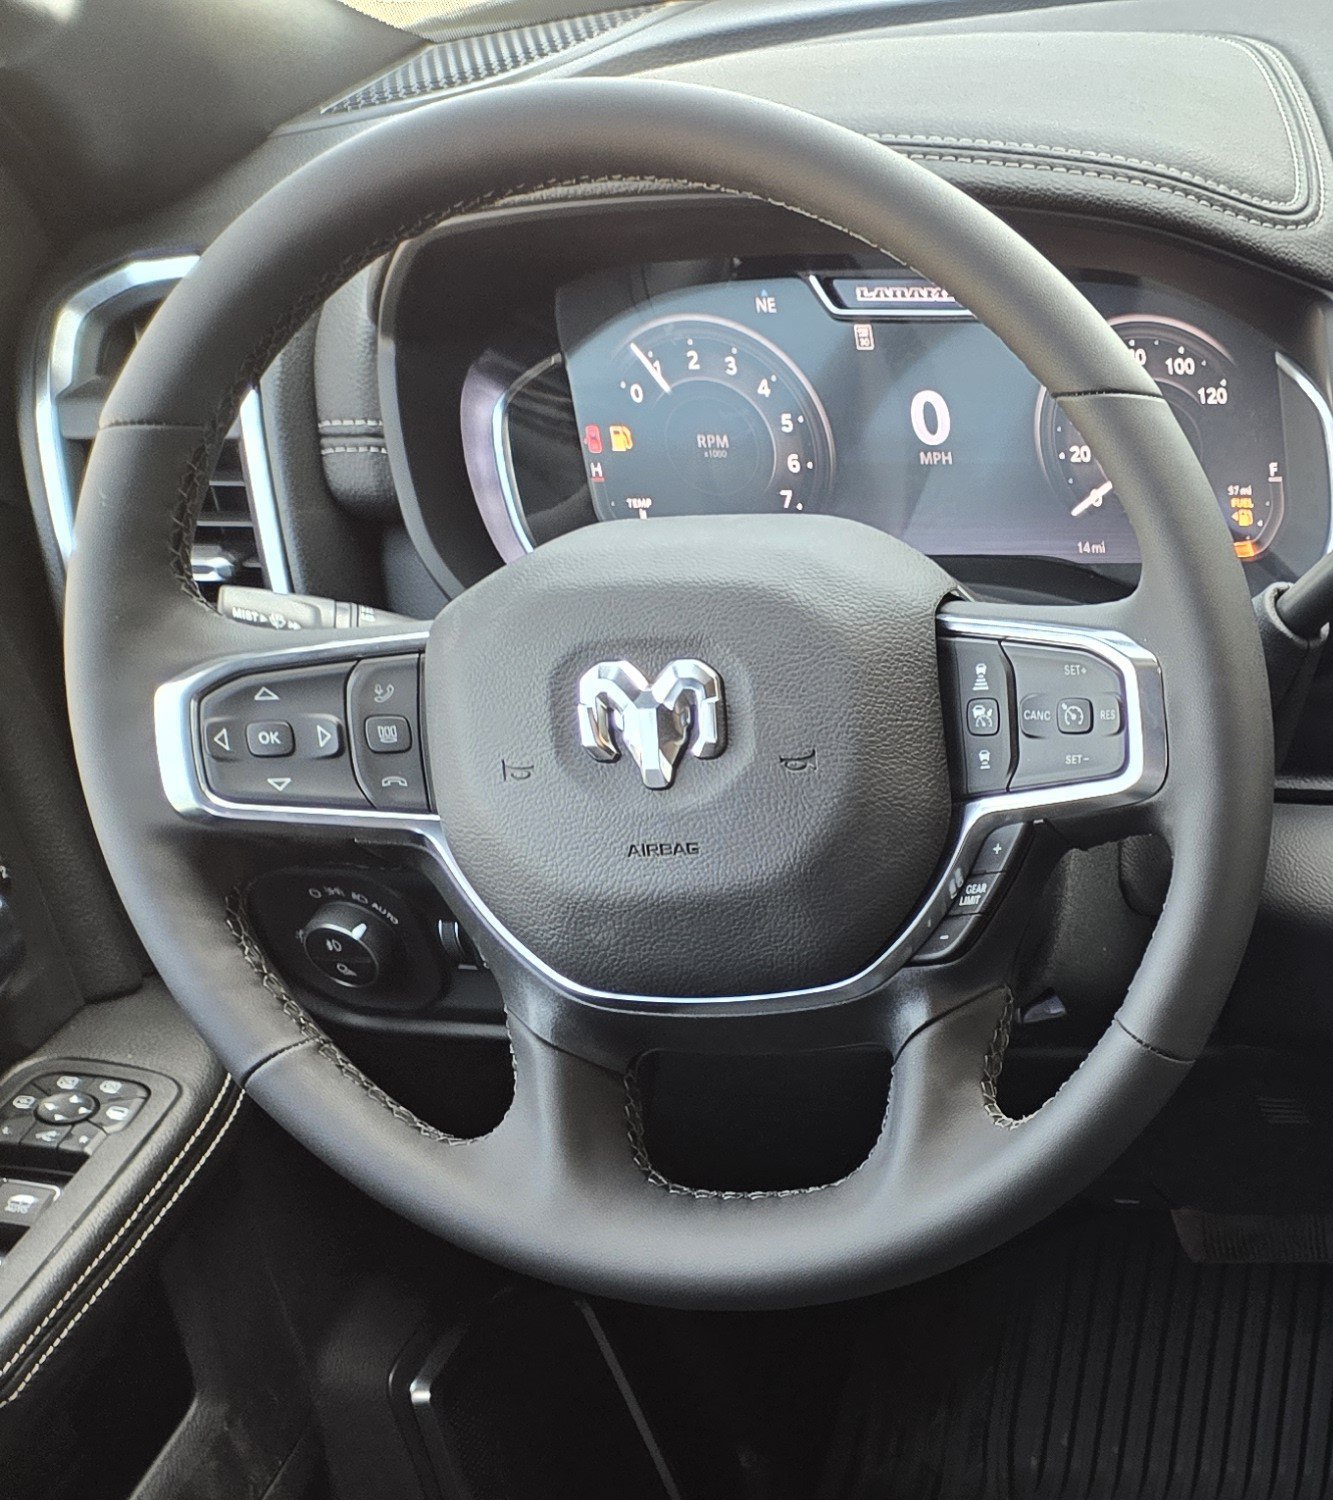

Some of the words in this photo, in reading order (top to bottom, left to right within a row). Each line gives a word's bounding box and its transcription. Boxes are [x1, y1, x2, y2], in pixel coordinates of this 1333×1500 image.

[755, 297, 777, 313] NE
[686, 350, 700, 370] 2
[725, 357, 738, 376] 3
[1165, 357, 1195, 376] 100
[630, 383, 644, 403] 0
[757, 379, 771, 398] 4
[1197, 387, 1228, 405] 120
[781, 414, 794, 433] 5
[910, 390, 951, 446] 0
[696, 434, 729, 448] RPM
[920, 452, 953, 465] MPH
[1069, 446, 1091, 463] 20
[589, 462, 603, 478] H
[787, 454, 801, 474] 6
[1269, 462, 1278, 477] F
[625, 497, 652, 509] TEMP
[780, 490, 793, 509] 7
[1231, 497, 1254, 509] FUEL
[232, 607, 259, 623] MIST
[1023, 710, 1051, 722] CANC
[1100, 710, 1116, 721] RES
[258, 731, 282, 745] OK
[628, 842, 700, 858] AIRBAG
[966, 882, 988, 895] GEAR
[959, 894, 982, 906] LIMIT
[372, 901, 399, 925] AUTO
